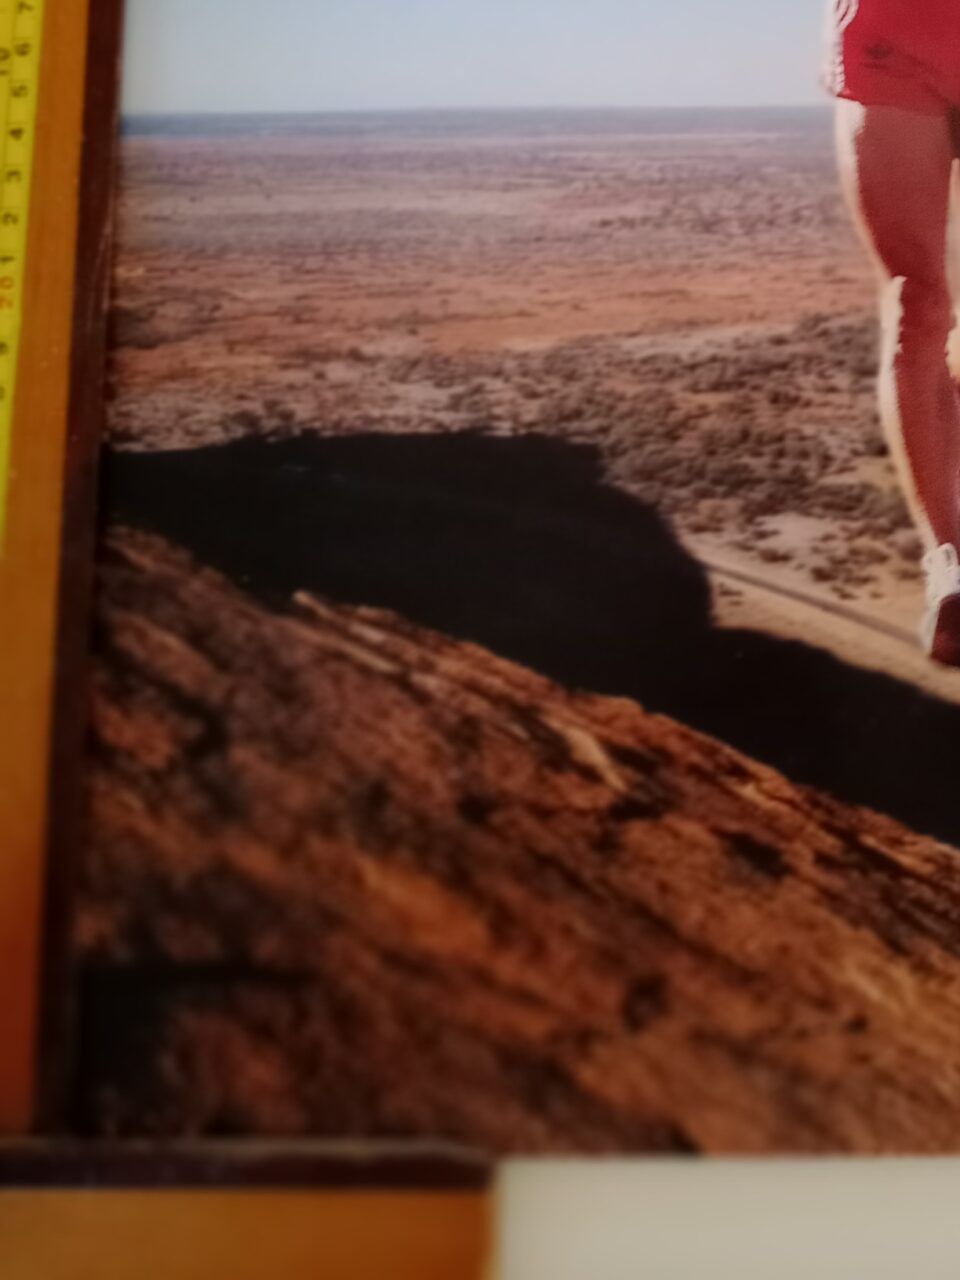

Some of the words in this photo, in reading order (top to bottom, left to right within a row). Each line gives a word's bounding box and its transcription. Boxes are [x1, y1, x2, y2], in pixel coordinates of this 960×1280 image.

[18, 1, 34, 15] 7
[14, 43, 31, 57] 6
[11, 84, 29, 99] 5
[8, 126, 25, 141] 4
[2, 211, 19, 227] 2
